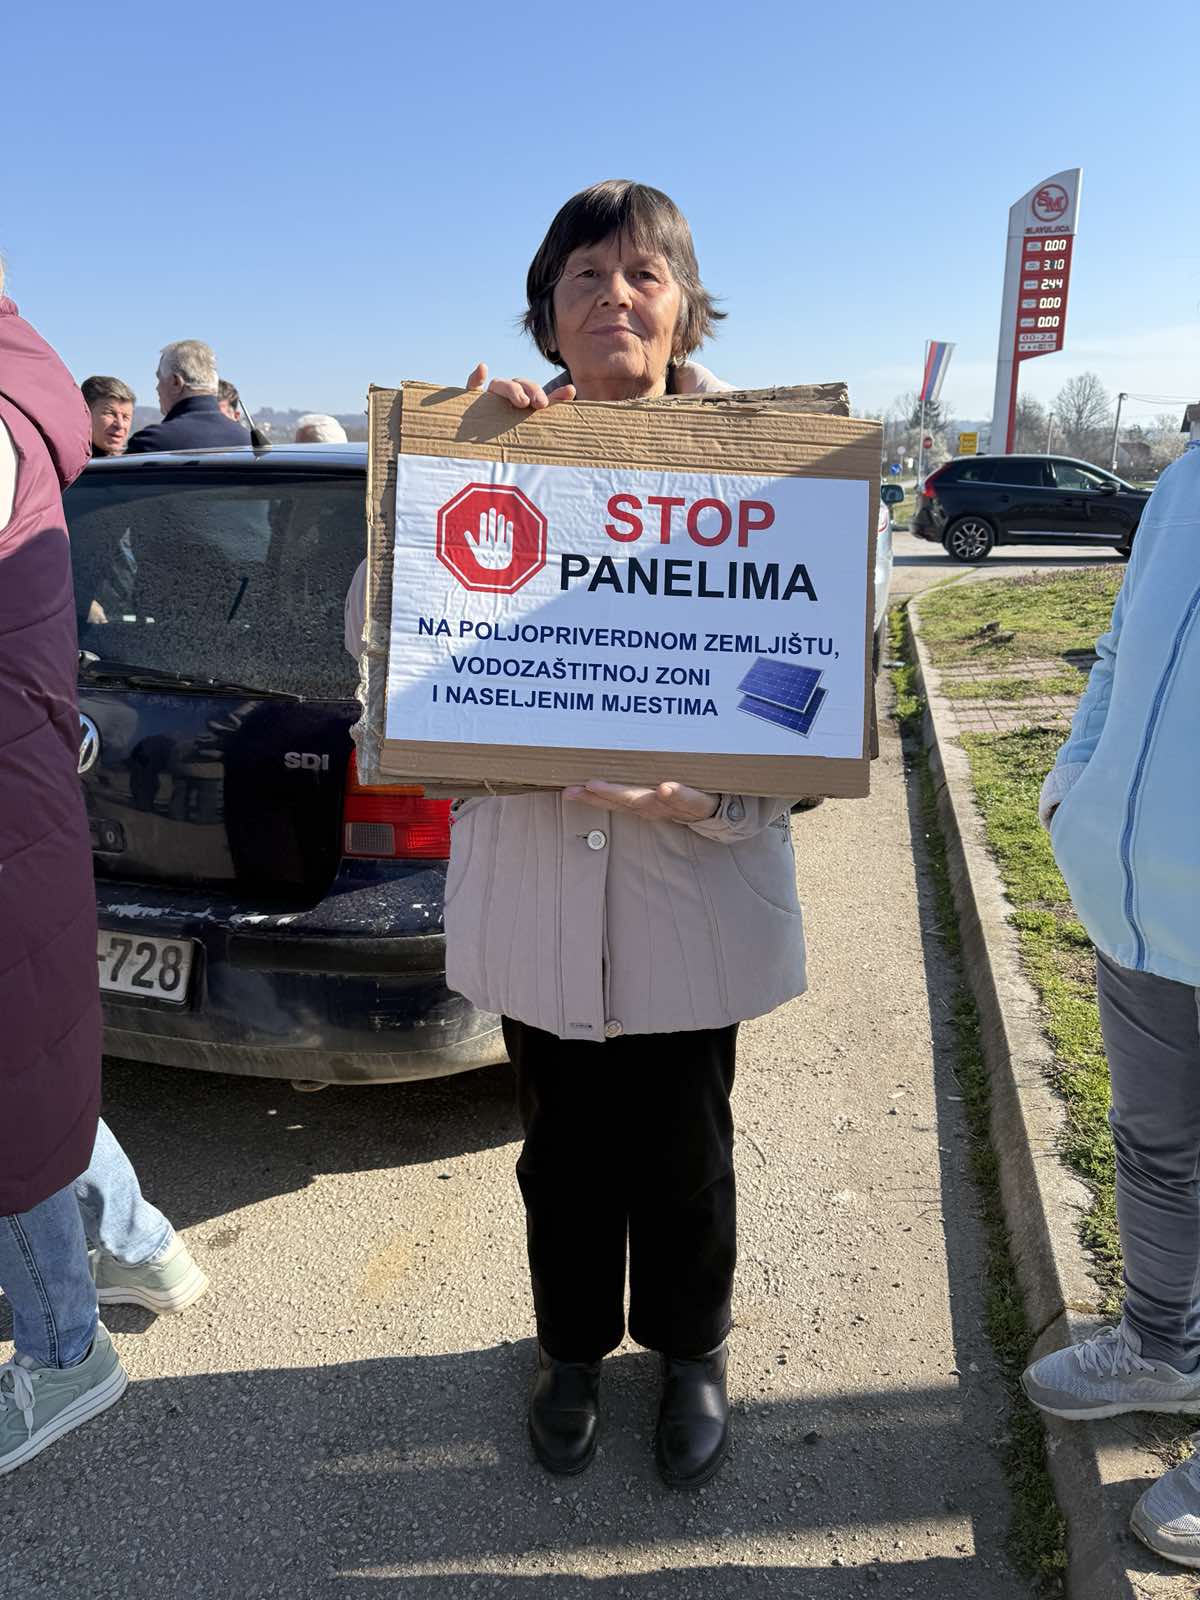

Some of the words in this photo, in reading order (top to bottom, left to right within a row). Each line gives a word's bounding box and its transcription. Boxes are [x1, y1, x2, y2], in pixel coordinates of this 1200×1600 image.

[605, 493, 775, 548] STOP
[561, 553, 818, 602] PANELIMA
[418, 617, 452, 637] NA
[459, 620, 697, 651] POLJOPRIVERDNOM
[703, 632, 840, 660] ZEMLJIŠTU,
[451, 655, 649, 684] VODOZAŠTITNOJ
[655, 666, 710, 687] ZONI
[432, 684, 438, 703] I
[445, 686, 594, 711] NASELJENIM
[601, 693, 719, 717] MJESTIMA
[284, 751, 329, 770] SDI
